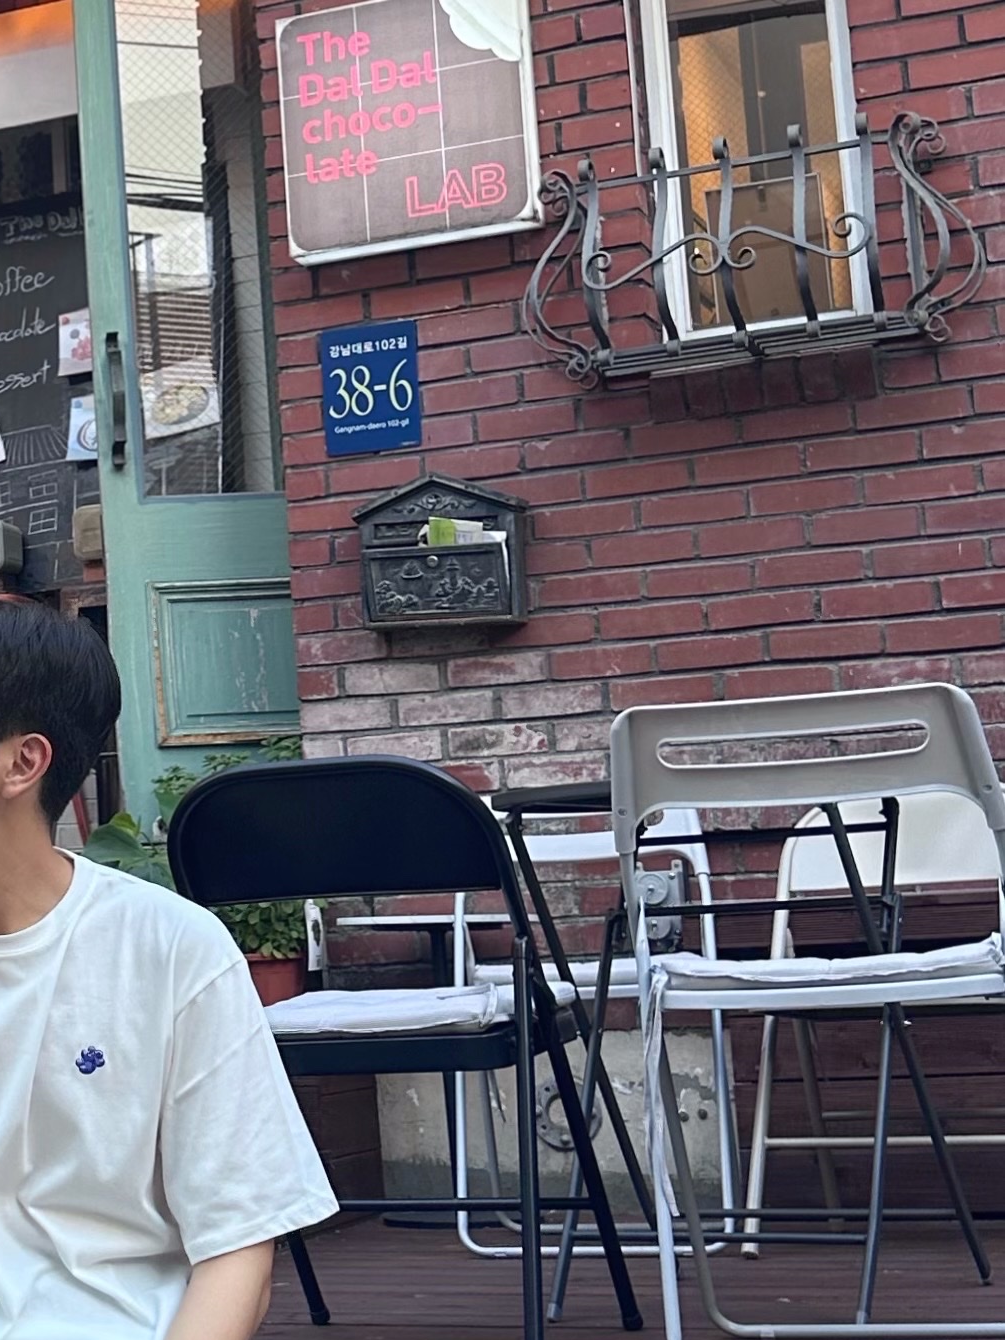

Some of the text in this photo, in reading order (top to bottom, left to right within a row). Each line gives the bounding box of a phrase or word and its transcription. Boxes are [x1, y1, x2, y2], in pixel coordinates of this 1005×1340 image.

[297, 30, 371, 66] The
[298, 51, 437, 107] Dal Dal
[302, 101, 442, 144] choco-
[305, 149, 379, 184] late
[405, 163, 508, 218] LAB
[329, 335, 408, 359] 강남대로102길
[328, 358, 413, 419] 38-6
